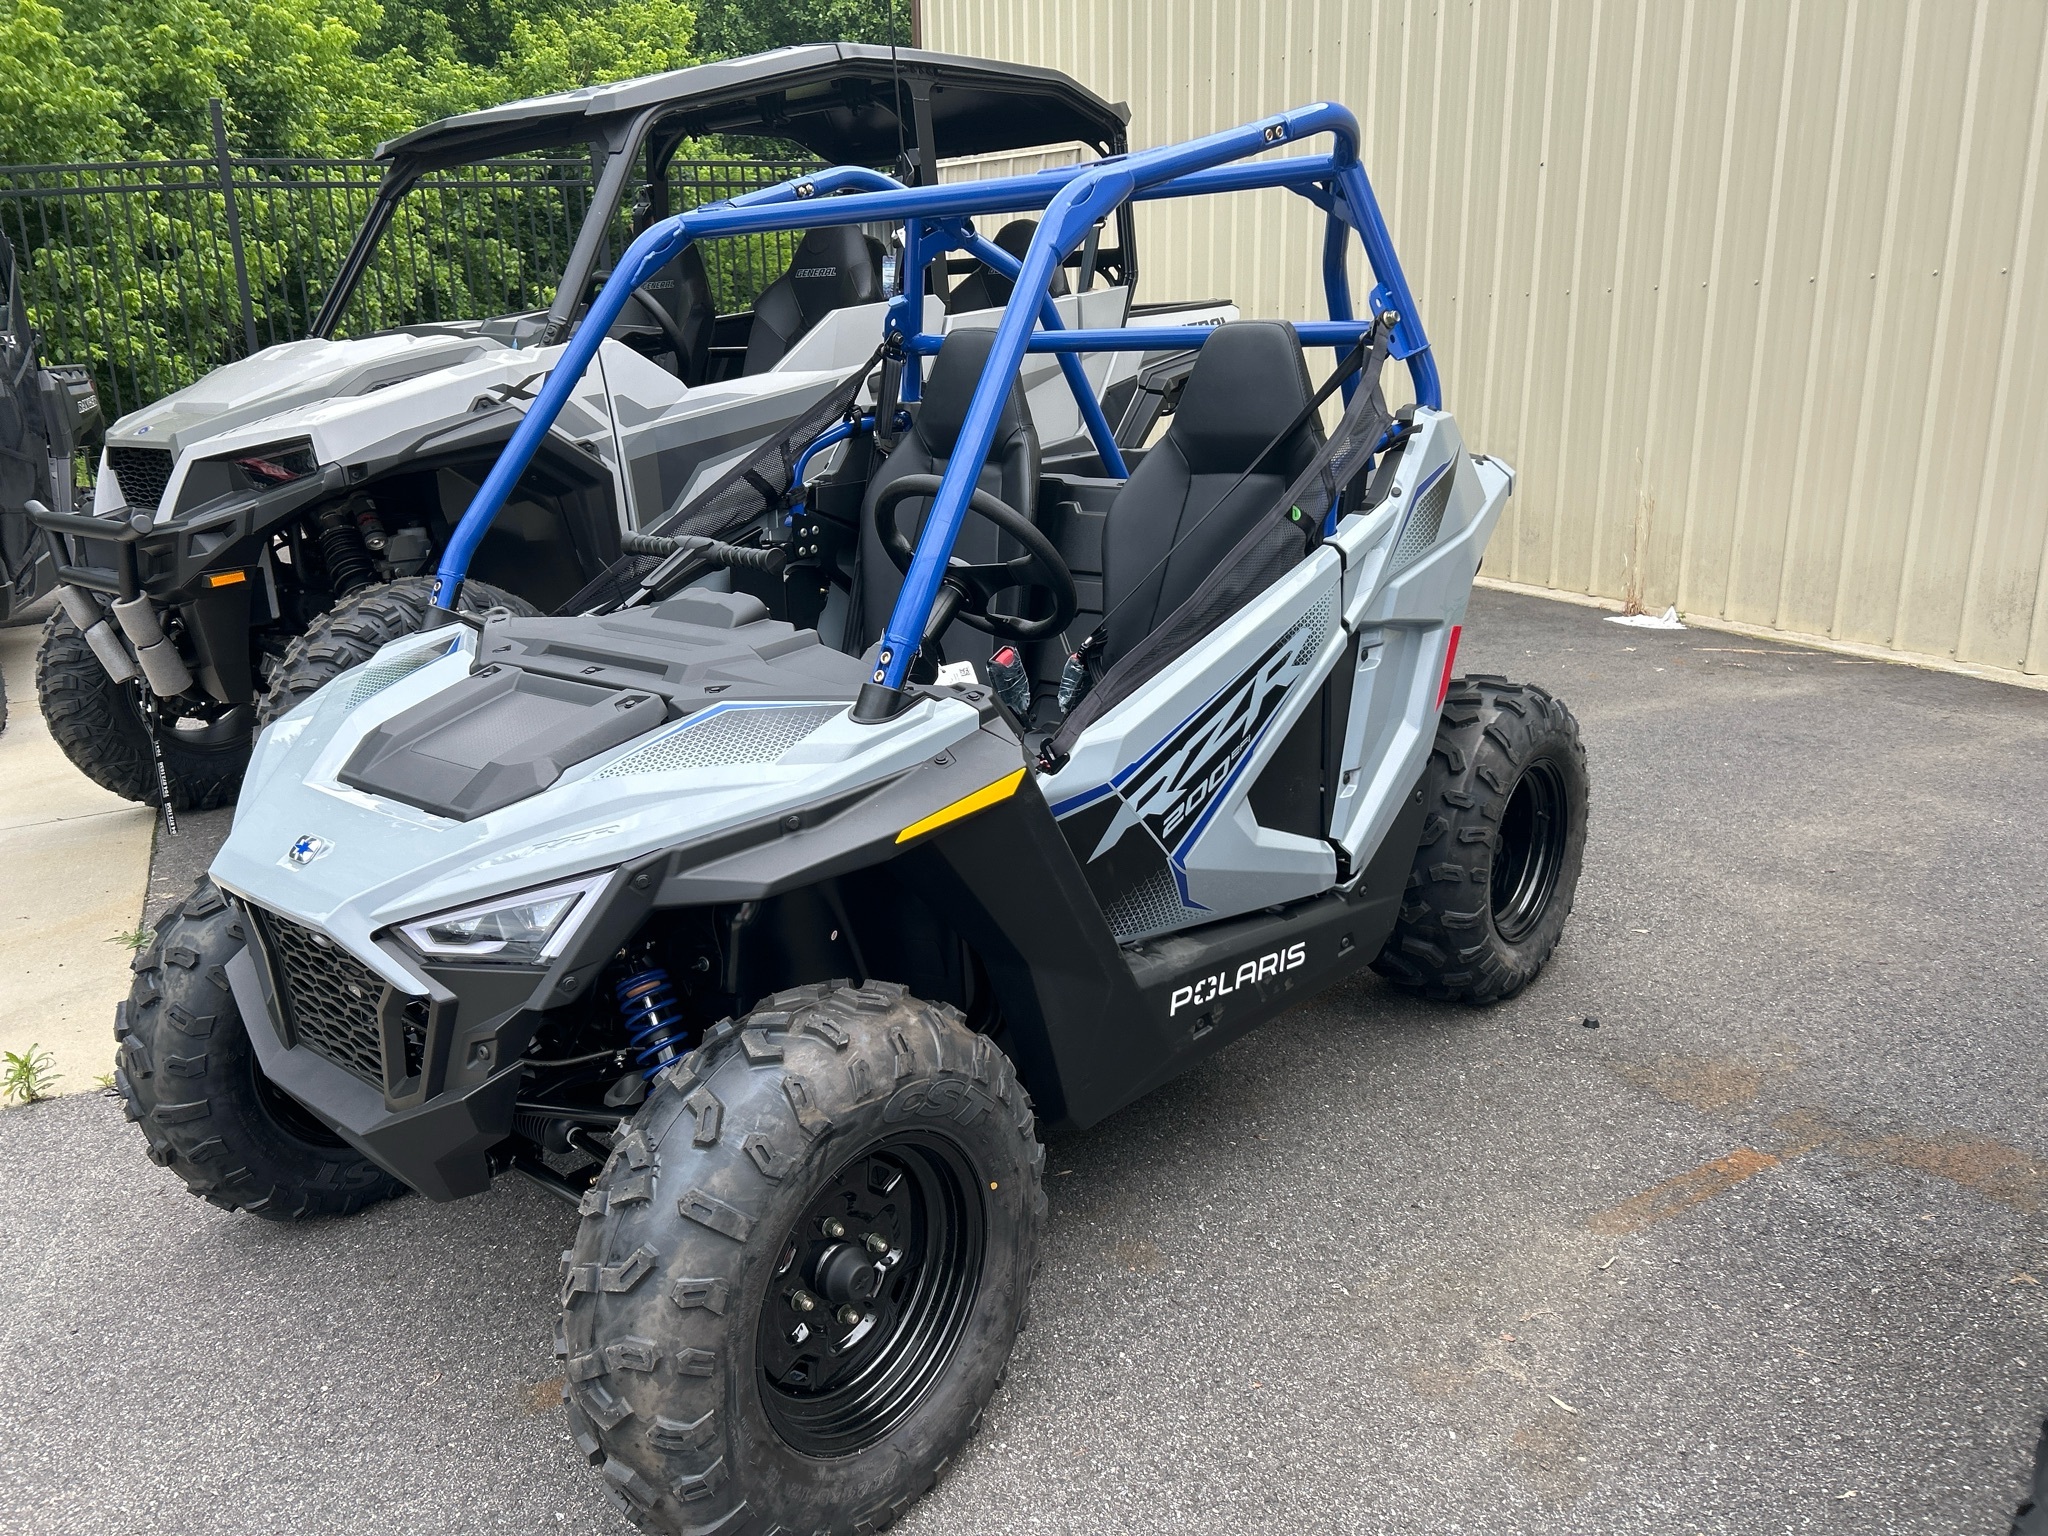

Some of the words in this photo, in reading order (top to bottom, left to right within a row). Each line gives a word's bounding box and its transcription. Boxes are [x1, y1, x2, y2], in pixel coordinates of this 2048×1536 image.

[795, 267, 837, 279] GENERAL
[1087, 627, 1313, 864] RZR
[1162, 755, 1231, 839] 200
[1169, 941, 1306, 1017] POLARIS
[883, 1078, 997, 1127] CST
